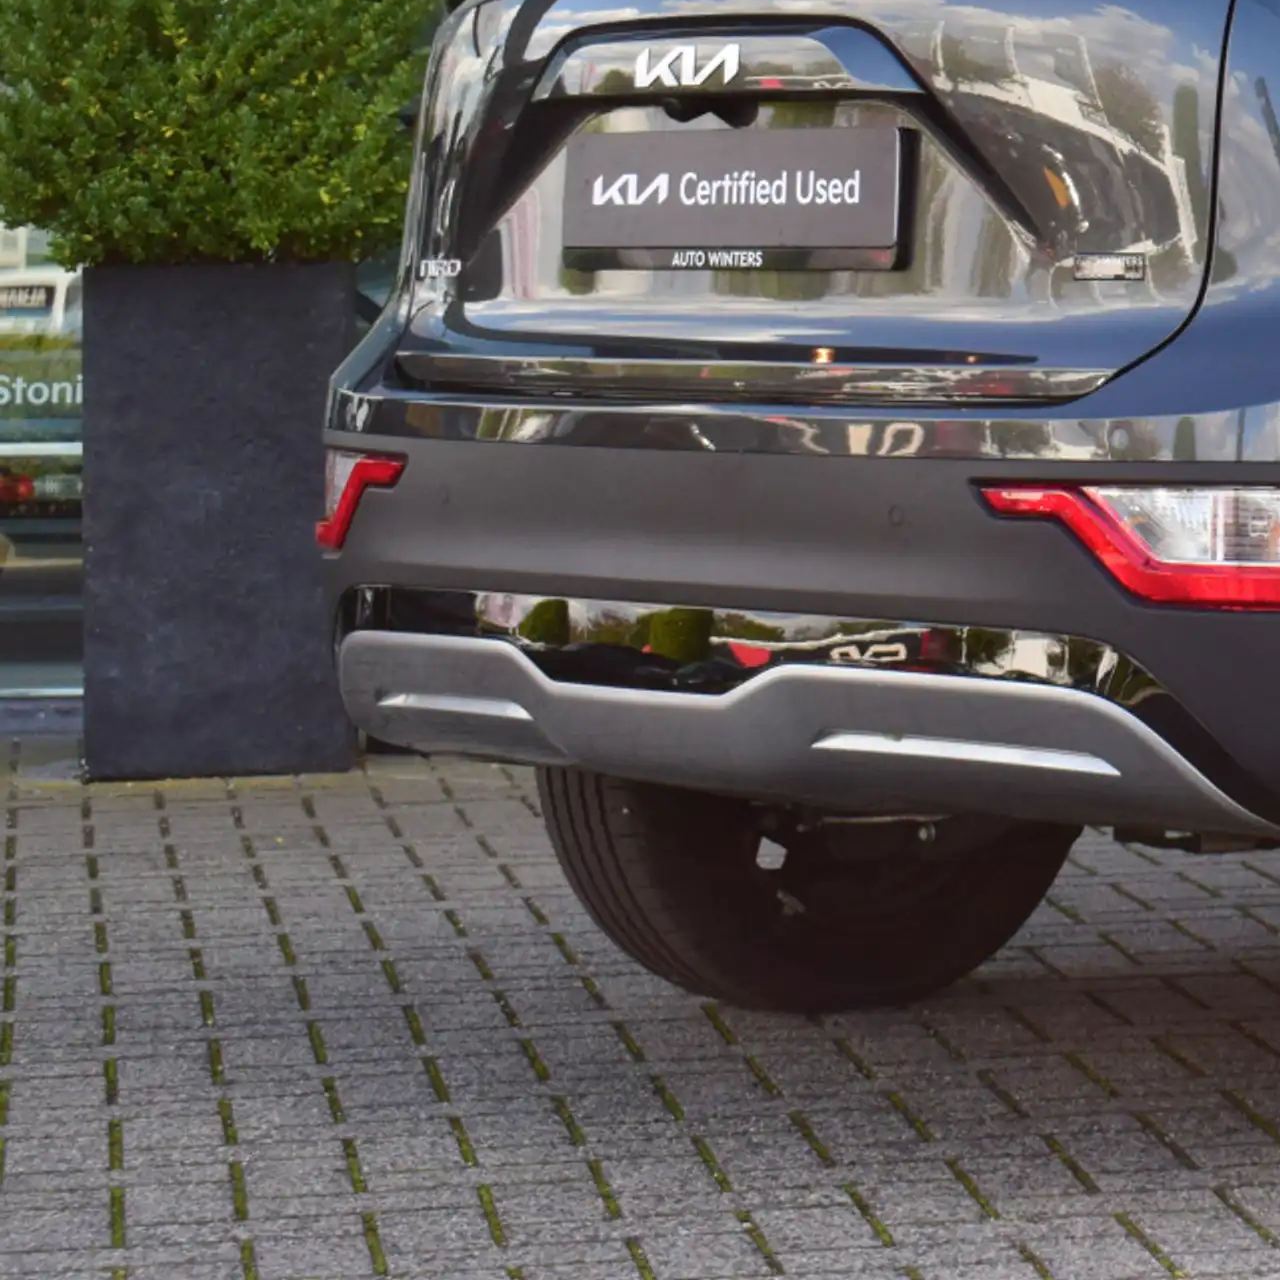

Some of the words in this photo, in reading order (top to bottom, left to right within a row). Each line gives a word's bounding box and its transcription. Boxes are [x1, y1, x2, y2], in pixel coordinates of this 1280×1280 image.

[630, 42, 740, 88] KIA
[591, 172, 670, 206] KIA
[679, 170, 788, 206] Certified
[795, 169, 861, 205] Used
[671, 251, 705, 267] AUTO
[707, 251, 763, 267] WINTERS
